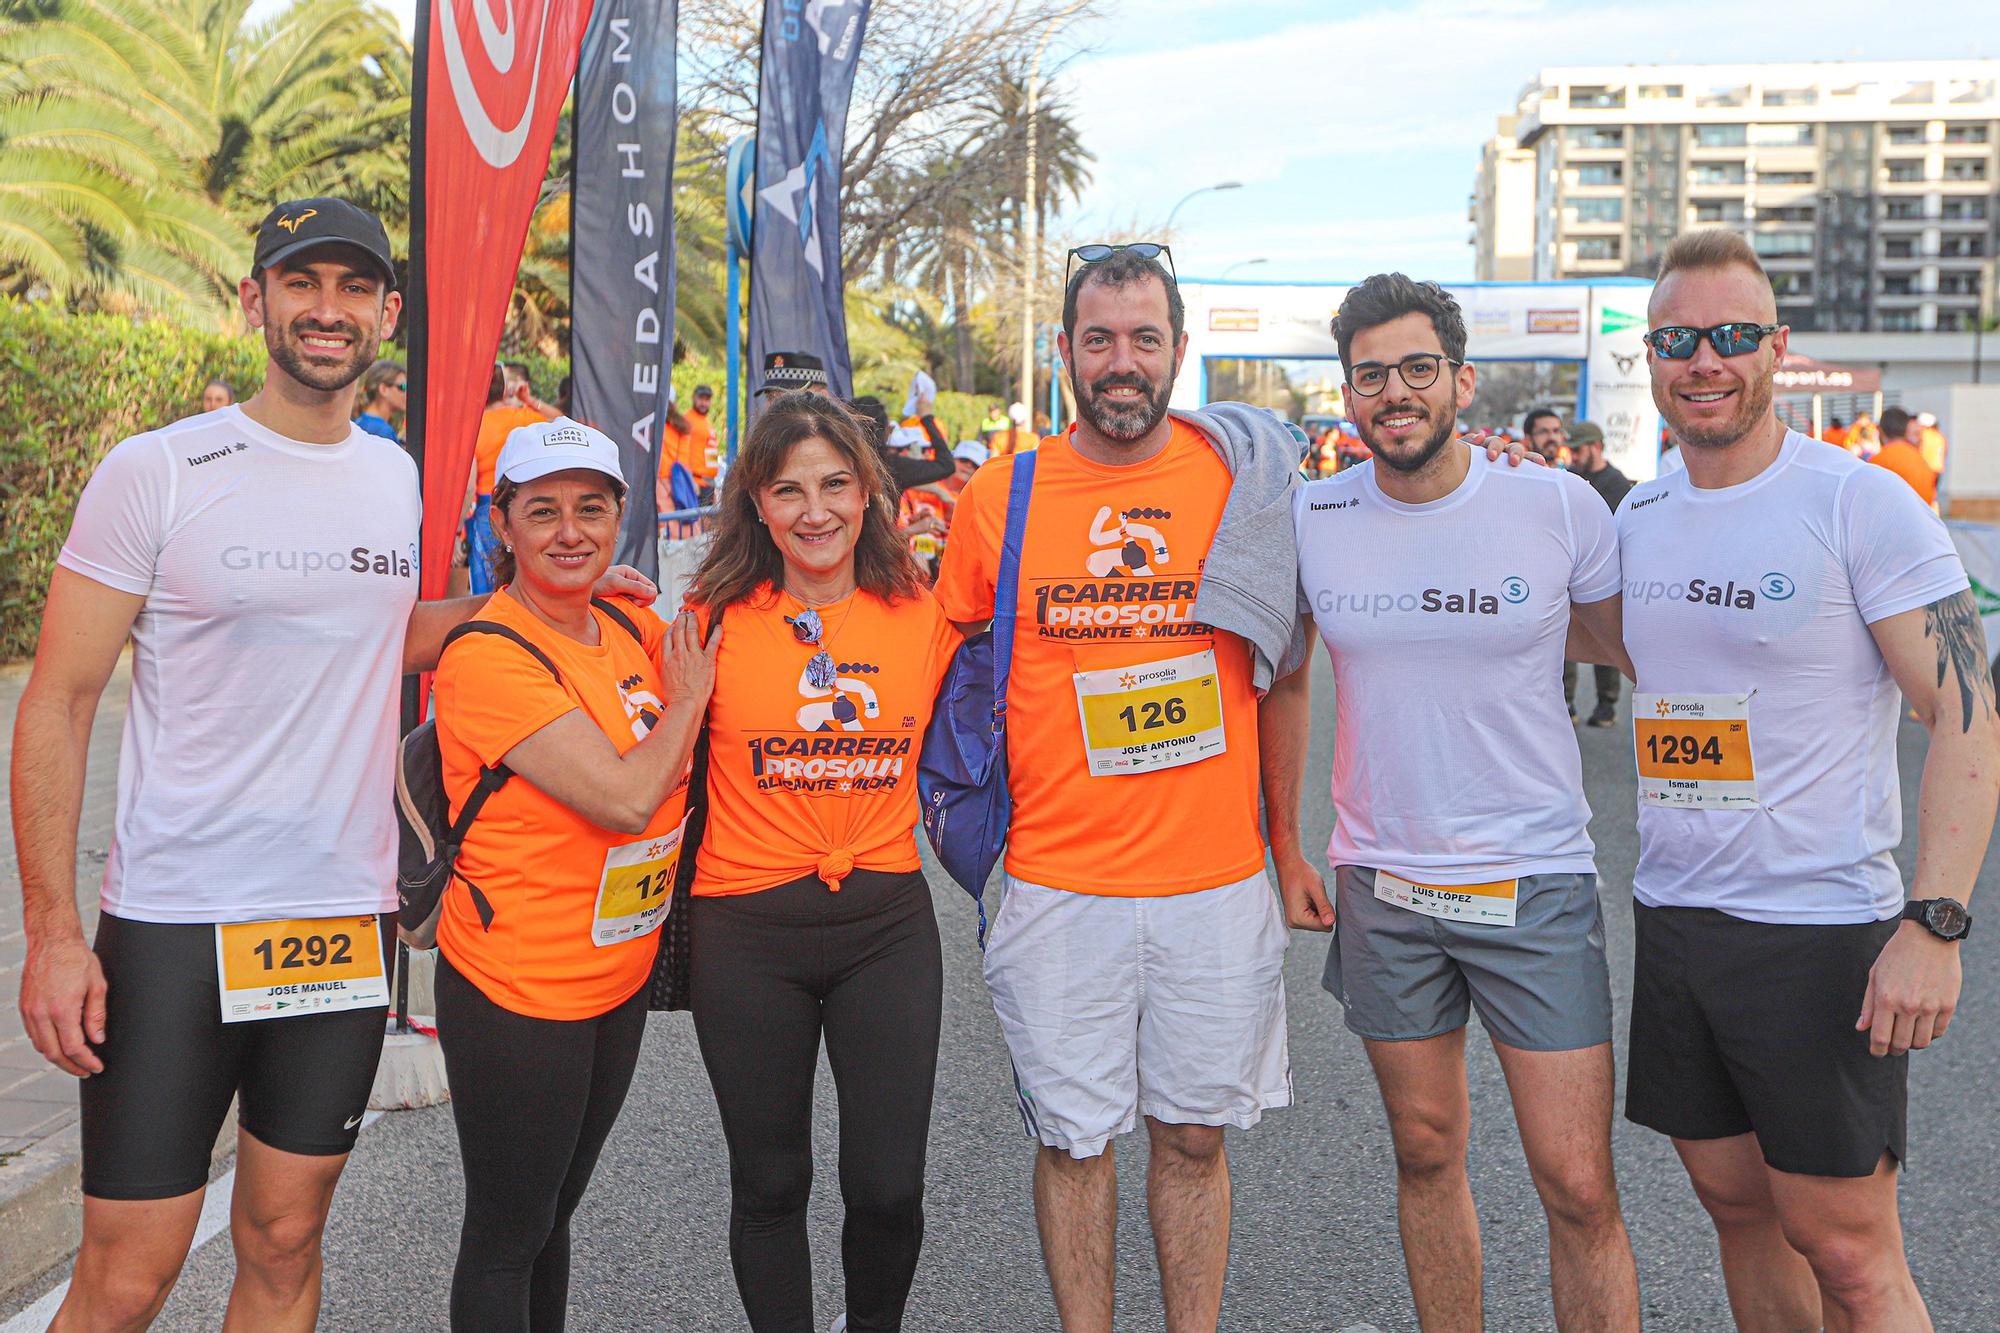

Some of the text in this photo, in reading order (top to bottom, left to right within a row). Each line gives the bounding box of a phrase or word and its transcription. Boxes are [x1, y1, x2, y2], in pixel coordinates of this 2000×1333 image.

[550, 430, 581, 438] AEDAS
[187, 445, 233, 467] luanvi
[1310, 500, 1347, 511] luanvi
[1630, 494, 1660, 511] luanvi
[1050, 580, 1198, 604] CARRER
[1622, 578, 1756, 610] rupoSala
[1048, 603, 1195, 626] PROSOLI
[1038, 623, 1215, 640] ALICANTE MUJER
[1139, 668, 1177, 683] prosolia
[1119, 697, 1187, 732] 126
[1671, 702, 1705, 713] prosolia
[764, 737, 912, 757] CARRERA
[1121, 743, 1148, 755] JOSÉ
[1150, 735, 1196, 751] ANTONIO
[1647, 734, 1723, 765] 1294
[757, 776, 838, 791] ALICANTE
[1668, 780, 1698, 789] Ismael
[1412, 886, 1435, 897] LUIS
[1437, 891, 1472, 903] LÓPEZ
[254, 934, 352, 970] 1292
[267, 981, 347, 997] JOSÉ MANUEL
